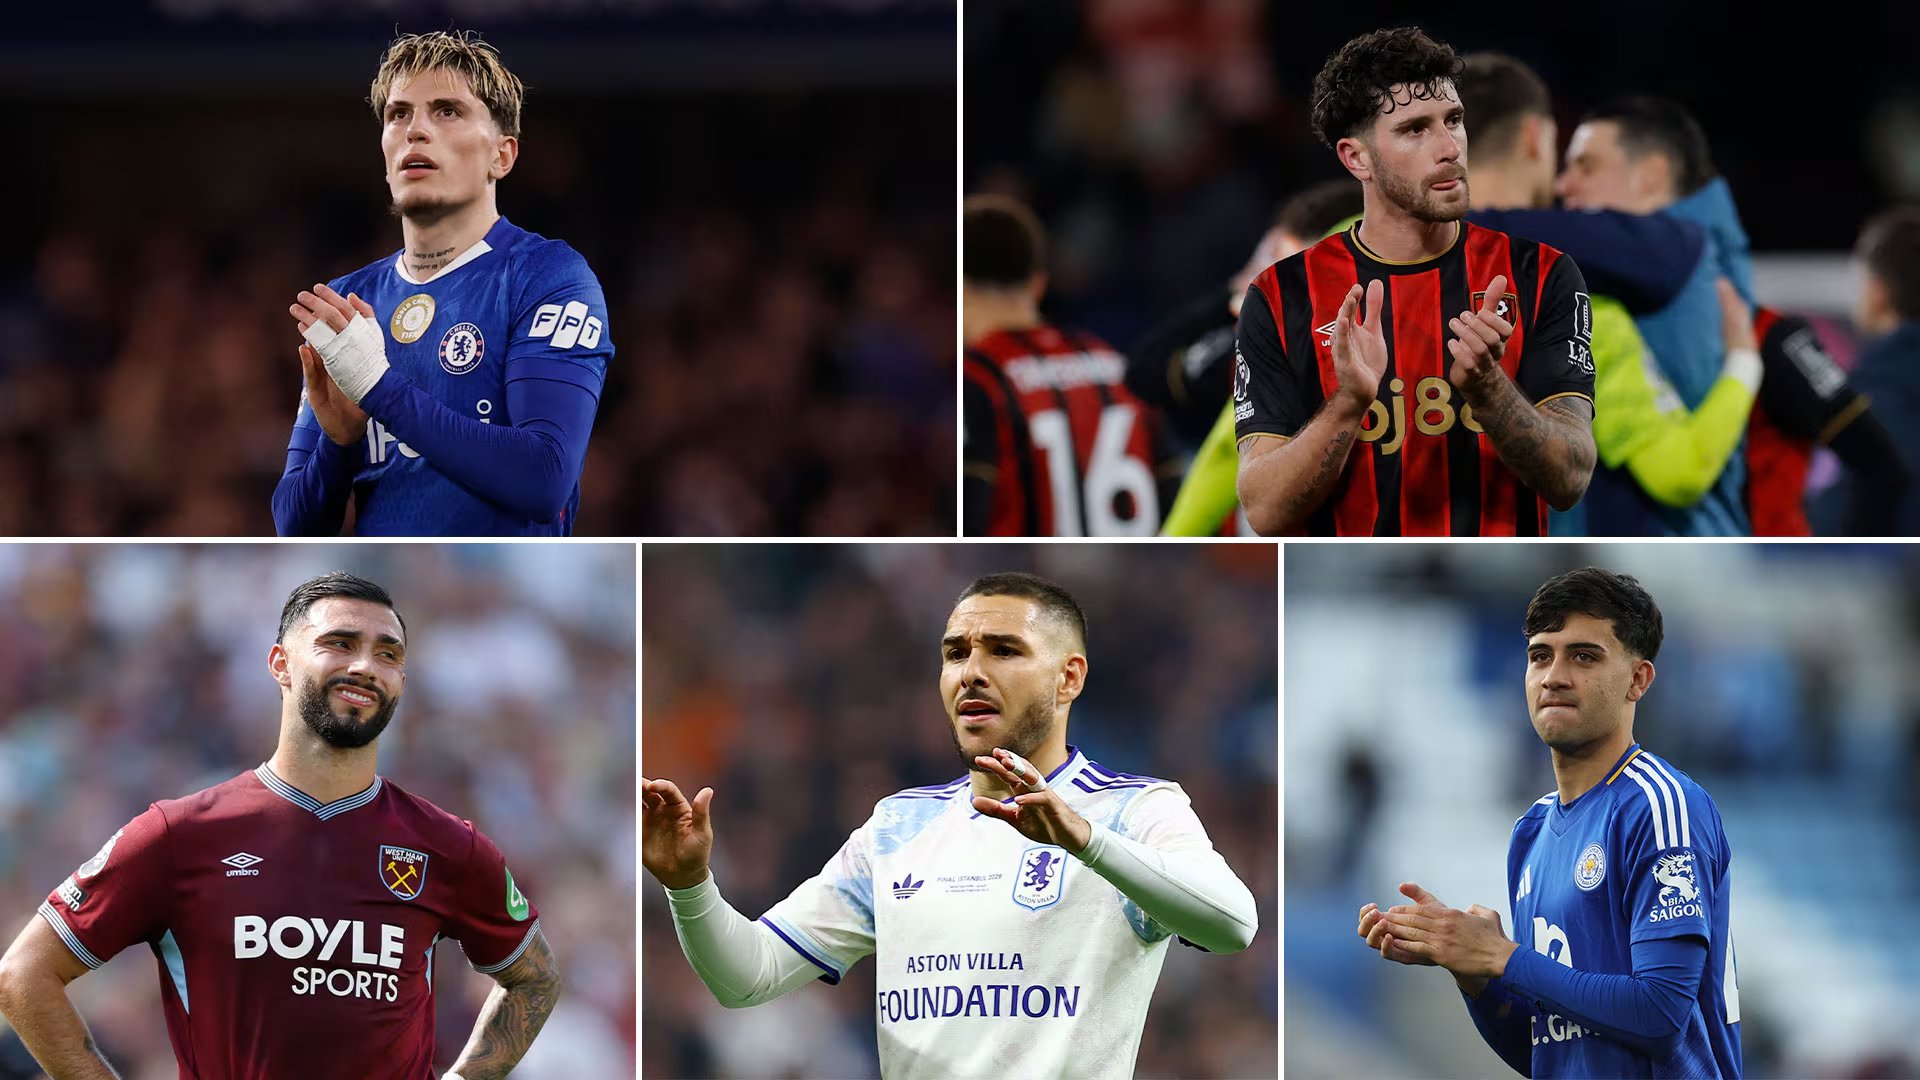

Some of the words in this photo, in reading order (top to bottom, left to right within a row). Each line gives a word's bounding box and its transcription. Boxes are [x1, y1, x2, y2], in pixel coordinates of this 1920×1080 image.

[449, 325, 477, 336] CHELSEA
[533, 310, 600, 342] FPT
[400, 331, 418, 339] FIFA
[1030, 403, 1161, 537] 16
[385, 848, 405, 856] WEST
[405, 851, 423, 862] HAM
[392, 855, 415, 864] UNITED
[226, 868, 259, 877] umbro
[1017, 894, 1036, 904] ASTON
[1037, 894, 1055, 904] VILLA
[1668, 896, 1686, 906] BIA
[1650, 904, 1703, 923] SAIGON
[234, 915, 405, 969] BOYLE
[907, 953, 961, 973] ASTON
[966, 953, 1024, 971] VILLA
[291, 966, 399, 1002] SPORTS
[878, 985, 1080, 1024] FOUNDATION
